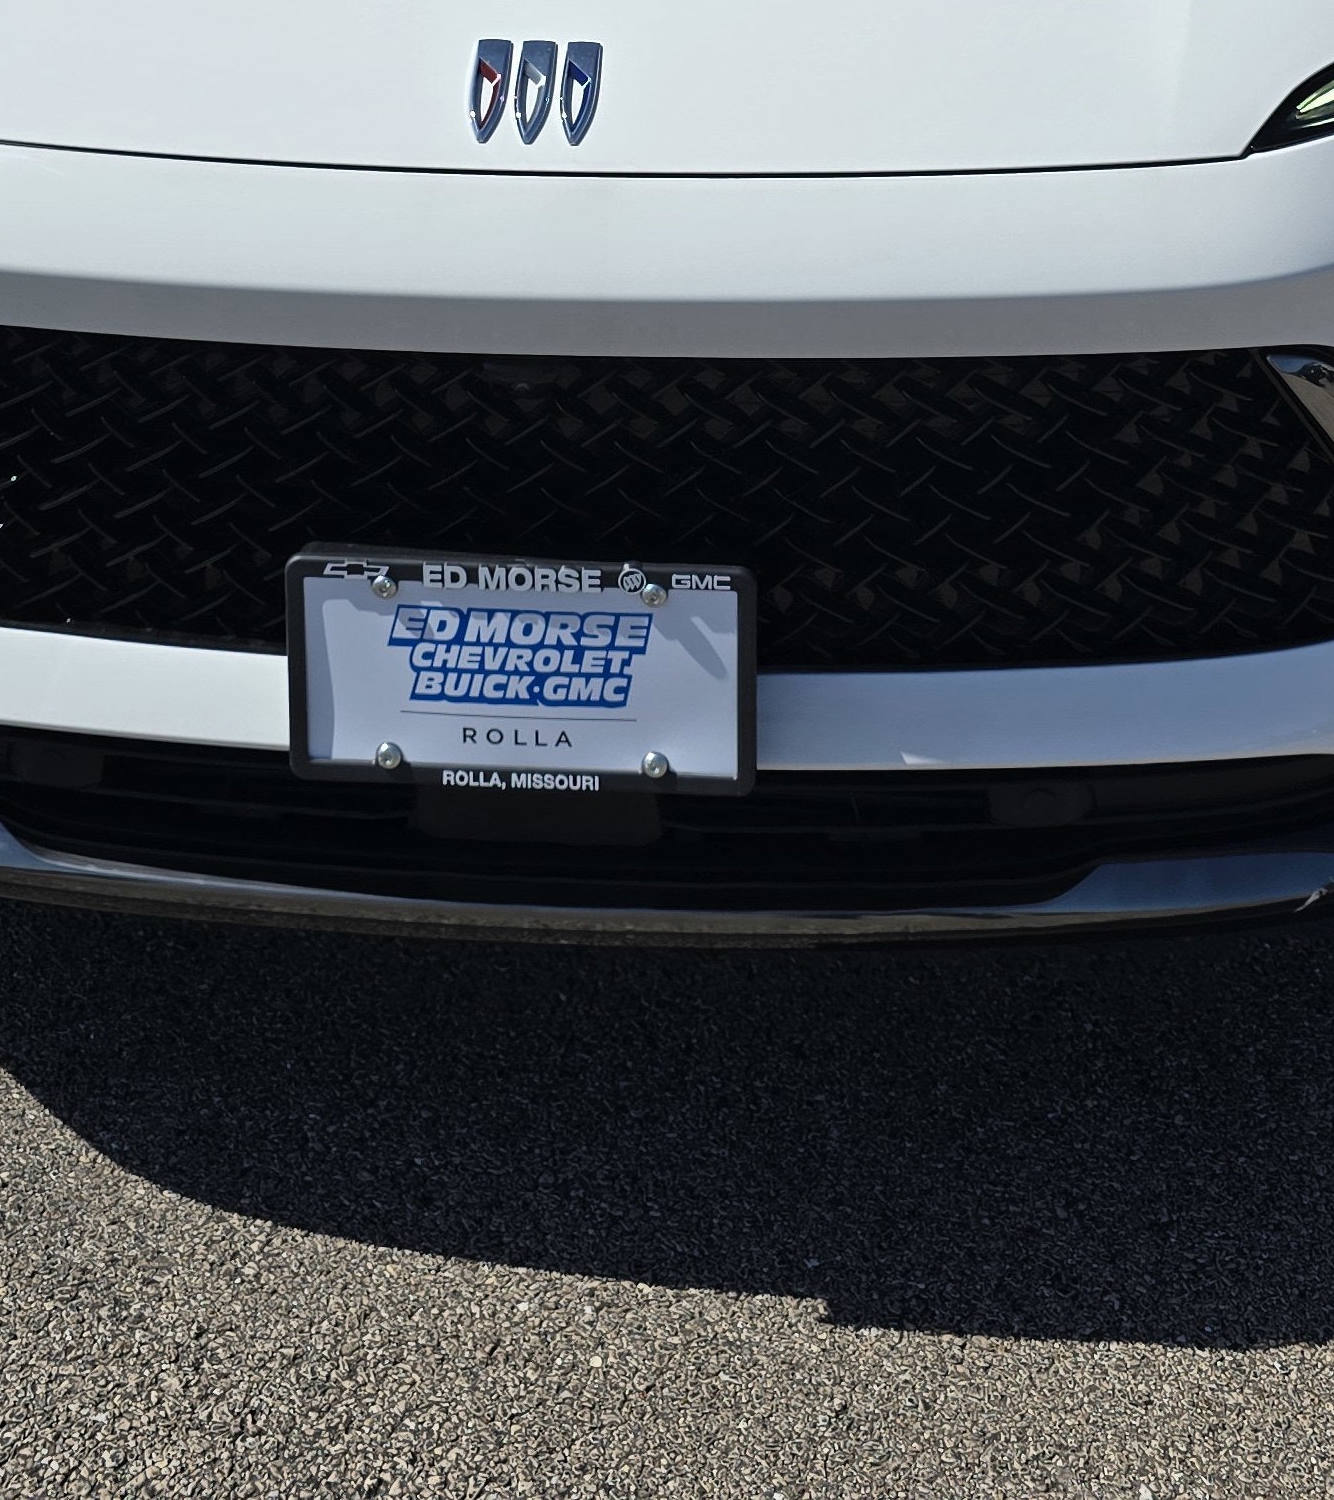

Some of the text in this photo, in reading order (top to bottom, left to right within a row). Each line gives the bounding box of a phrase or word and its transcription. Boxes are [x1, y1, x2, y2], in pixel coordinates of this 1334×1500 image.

[422, 562, 732, 593] ED MORSE GMC
[391, 606, 650, 648] ED MORSE
[412, 642, 630, 674] CHEVROLET
[461, 727, 573, 748] ROLLA
[442, 769, 600, 792] ROLLA, MISSOURI
